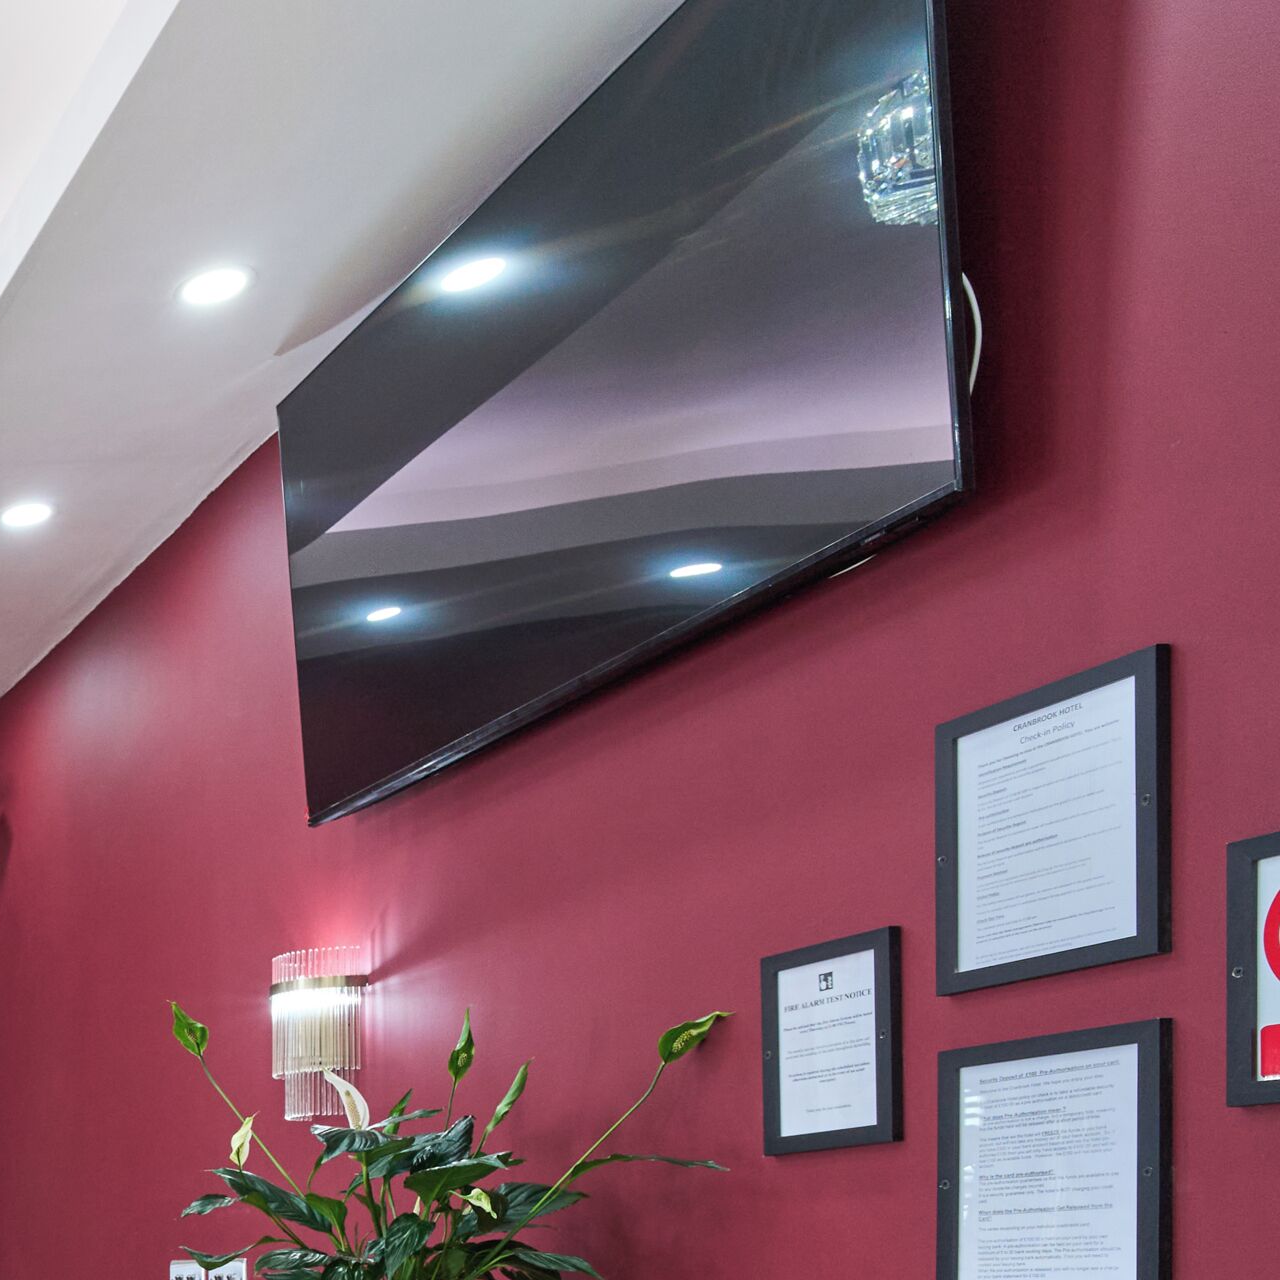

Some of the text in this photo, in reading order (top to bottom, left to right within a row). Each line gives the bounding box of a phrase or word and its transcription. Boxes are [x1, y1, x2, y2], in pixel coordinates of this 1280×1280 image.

[1013, 703, 1083, 732] CRANBROOK HOTEL
[1020, 721, 1076, 744] Check-in Policy
[783, 988, 872, 1013] FIRE ALARM TEST NOTICE
